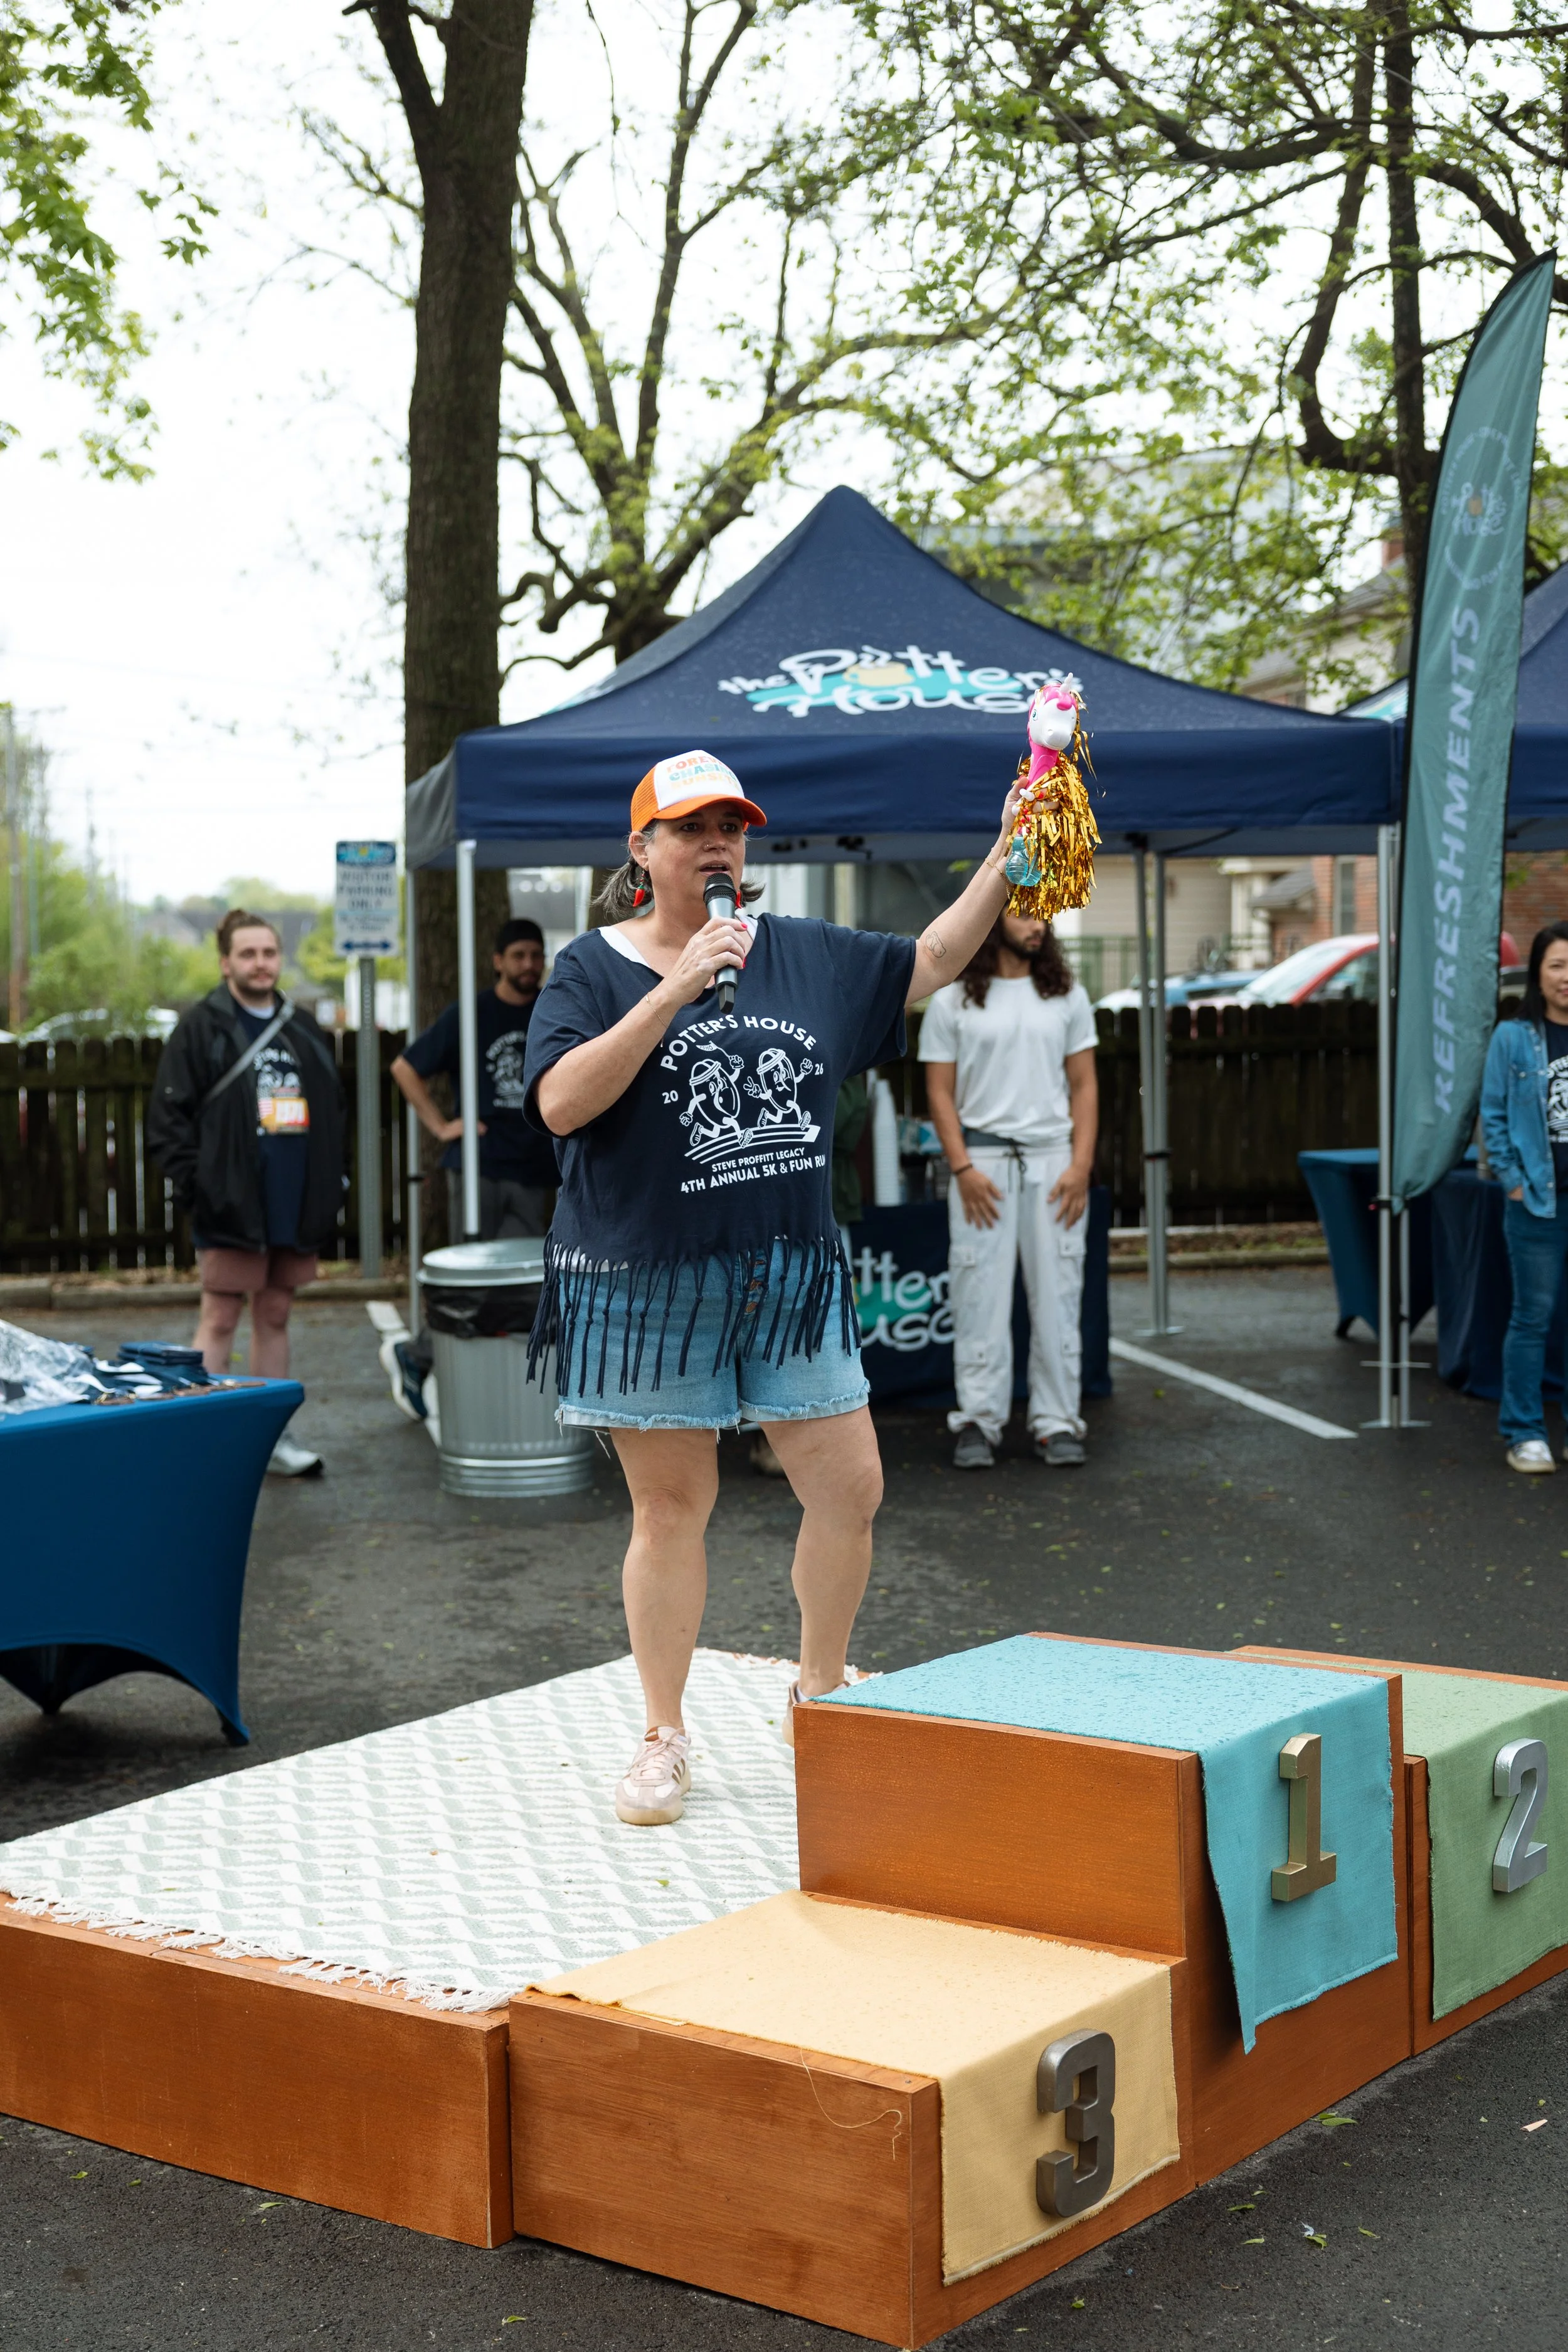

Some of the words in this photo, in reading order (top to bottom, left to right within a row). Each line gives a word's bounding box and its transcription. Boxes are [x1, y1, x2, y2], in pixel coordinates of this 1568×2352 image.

[718, 674, 790, 694] the
[752, 684, 1035, 719] Hous
[1433, 606, 1480, 1115] REFRESHMENTS
[660, 1014, 738, 1071] POTTER'S
[743, 1015, 817, 1051] HOUSE
[815, 1063, 824, 1076] 26
[662, 1090, 679, 1104] 20
[681, 1178, 706, 1194] 4TH
[710, 1167, 760, 1189] ANNUAL
[763, 1163, 778, 1177] 5K
[780, 1162, 788, 1174] &
[789, 1157, 813, 1172] FUN
[711, 1160, 737, 1172] STEVE
[738, 1152, 774, 1166] PROFFITT
[776, 1147, 805, 1160] LEGACY
[852, 1246, 950, 1310] tter
[857, 1306, 955, 1352] use
[1271, 1733, 1337, 1902] 1
[1493, 1738, 1549, 1894] 2
[1036, 2028, 1116, 2218] 3
